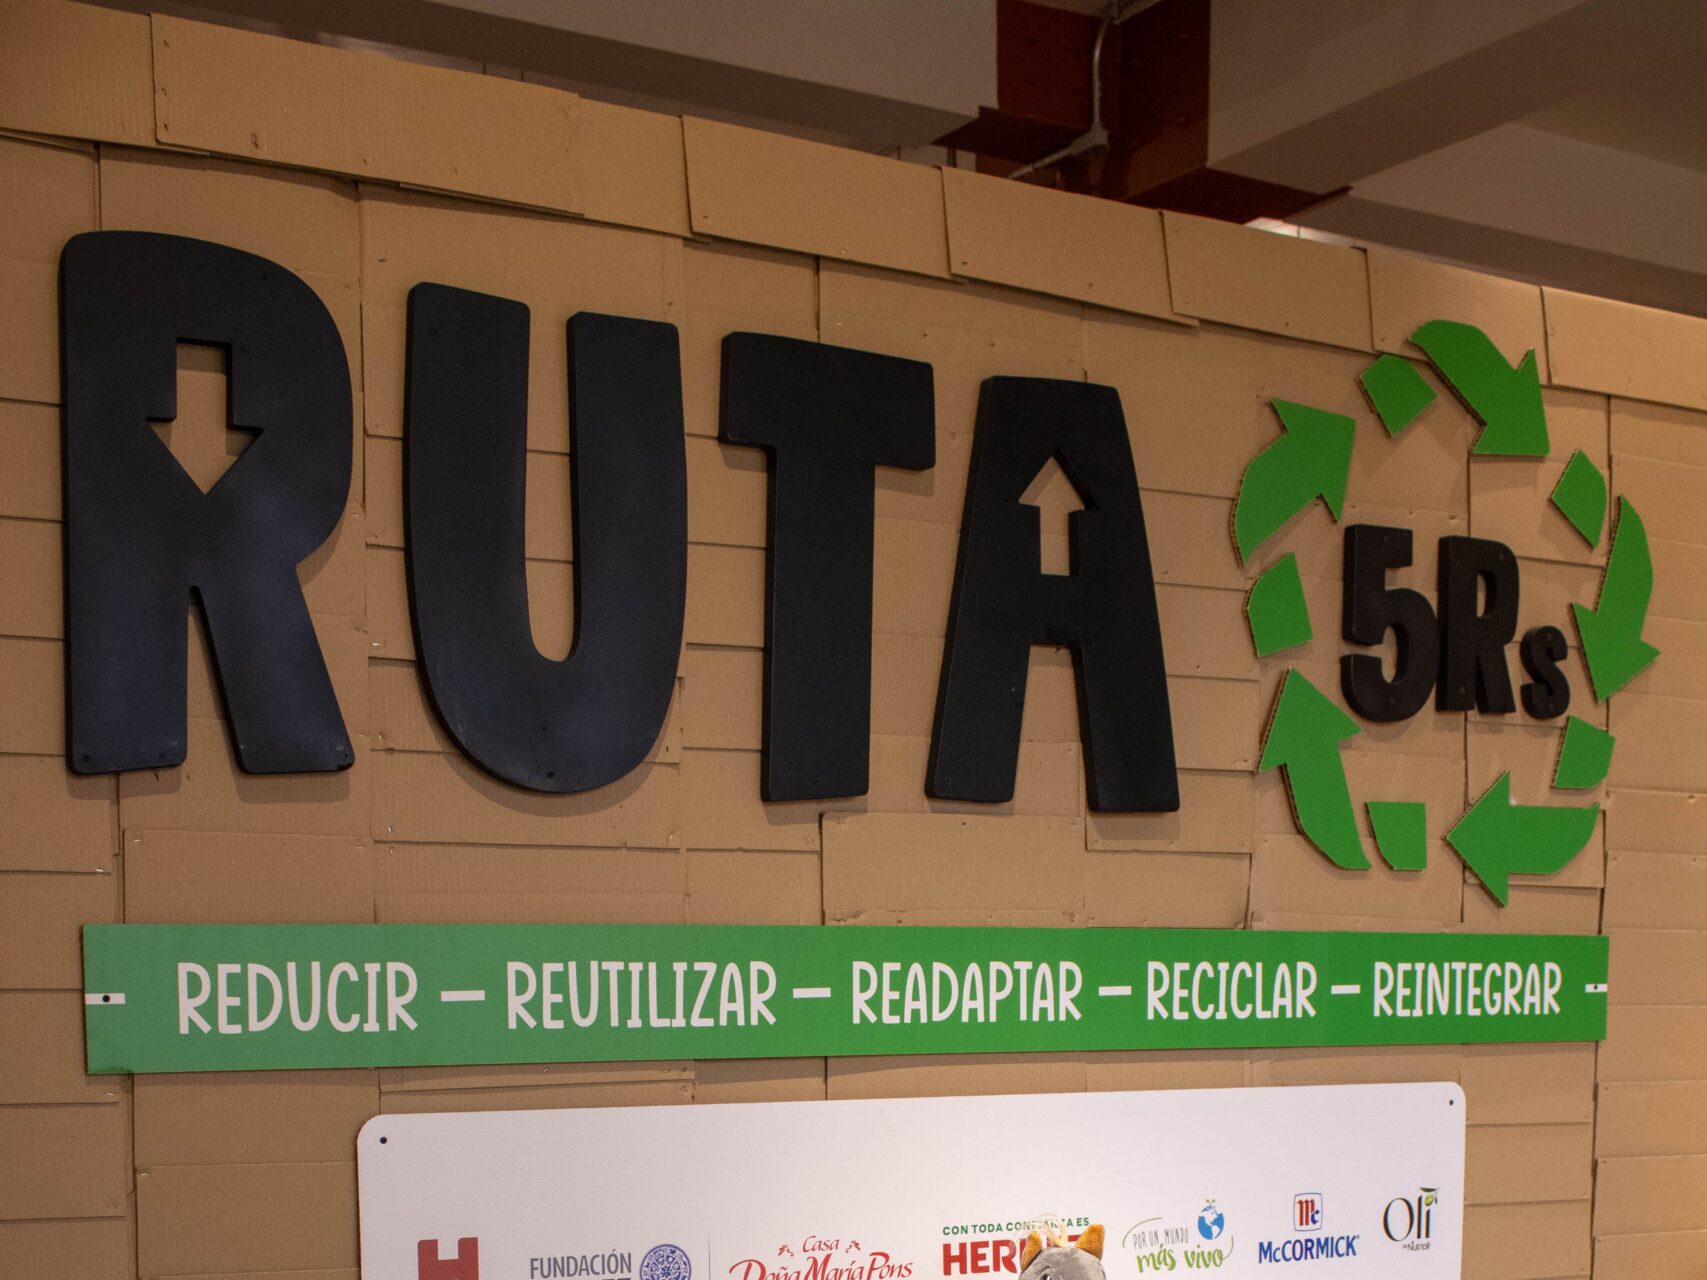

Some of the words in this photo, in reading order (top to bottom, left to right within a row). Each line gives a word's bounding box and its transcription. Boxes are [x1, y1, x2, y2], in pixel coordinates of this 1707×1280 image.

[60, 230, 1179, 814] RUTA
[1340, 524, 1570, 724] 5Rs
[177, 961, 418, 1035] REDUCIR
[507, 960, 777, 1030] REUTILIZAR
[851, 961, 1083, 1025] READAPTAR
[1146, 961, 1318, 1021] RECICLAR
[1373, 960, 1562, 1017] REINTEGRAR
[942, 1226, 969, 1236] CON
[972, 1223, 1003, 1234] TODA
[1077, 1217, 1090, 1227] ES
[1133, 1231, 1147, 1250] POR
[1149, 1229, 1160, 1247] UN
[1164, 1227, 1189, 1245] MUNDO
[802, 1235, 840, 1253] Casa
[1136, 1243, 1177, 1273] más
[1184, 1244, 1224, 1269] vivo
[1258, 1235, 1358, 1264] McCORMICK
[530, 1249, 632, 1280] FUNDACIÓN
